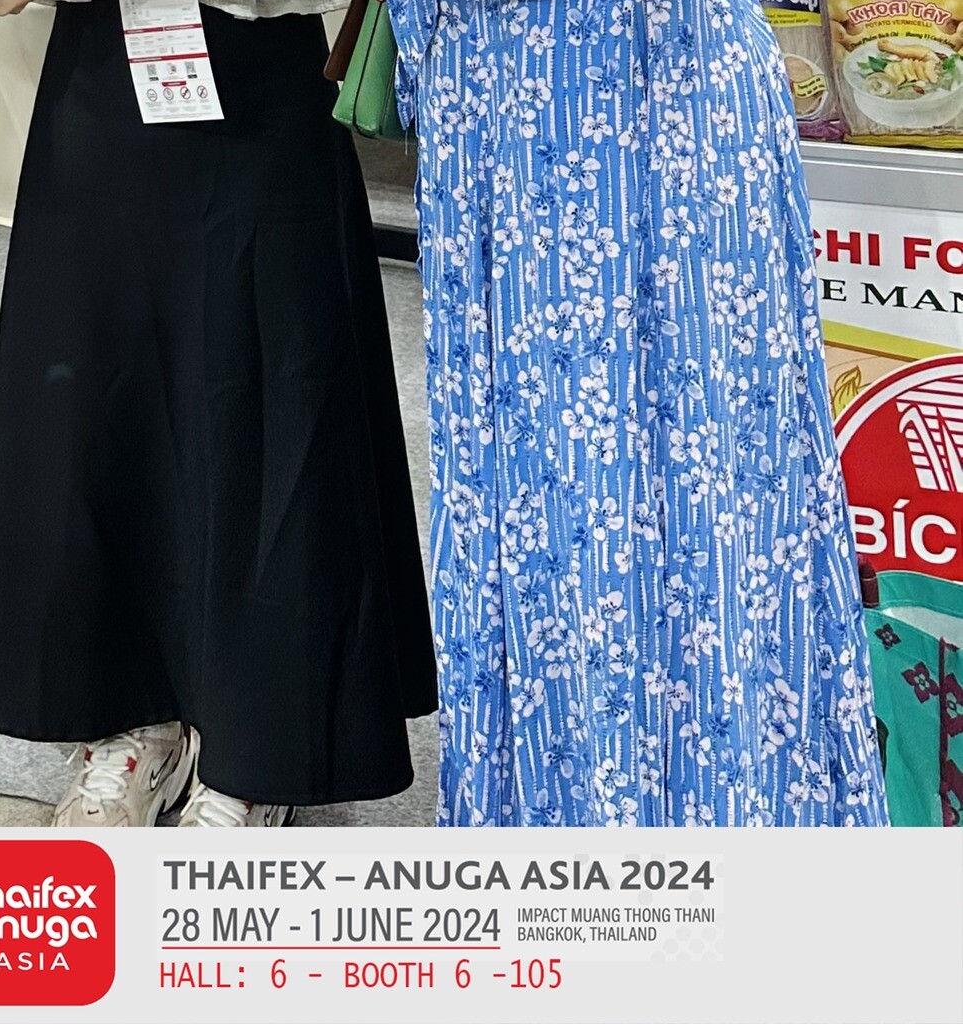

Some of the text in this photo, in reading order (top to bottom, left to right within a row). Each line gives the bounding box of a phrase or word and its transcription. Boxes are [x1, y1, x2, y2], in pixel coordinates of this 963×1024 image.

[848, 0, 951, 25] KHOAI TÂY
[865, 20, 933, 28] POTATO VERMICELLI
